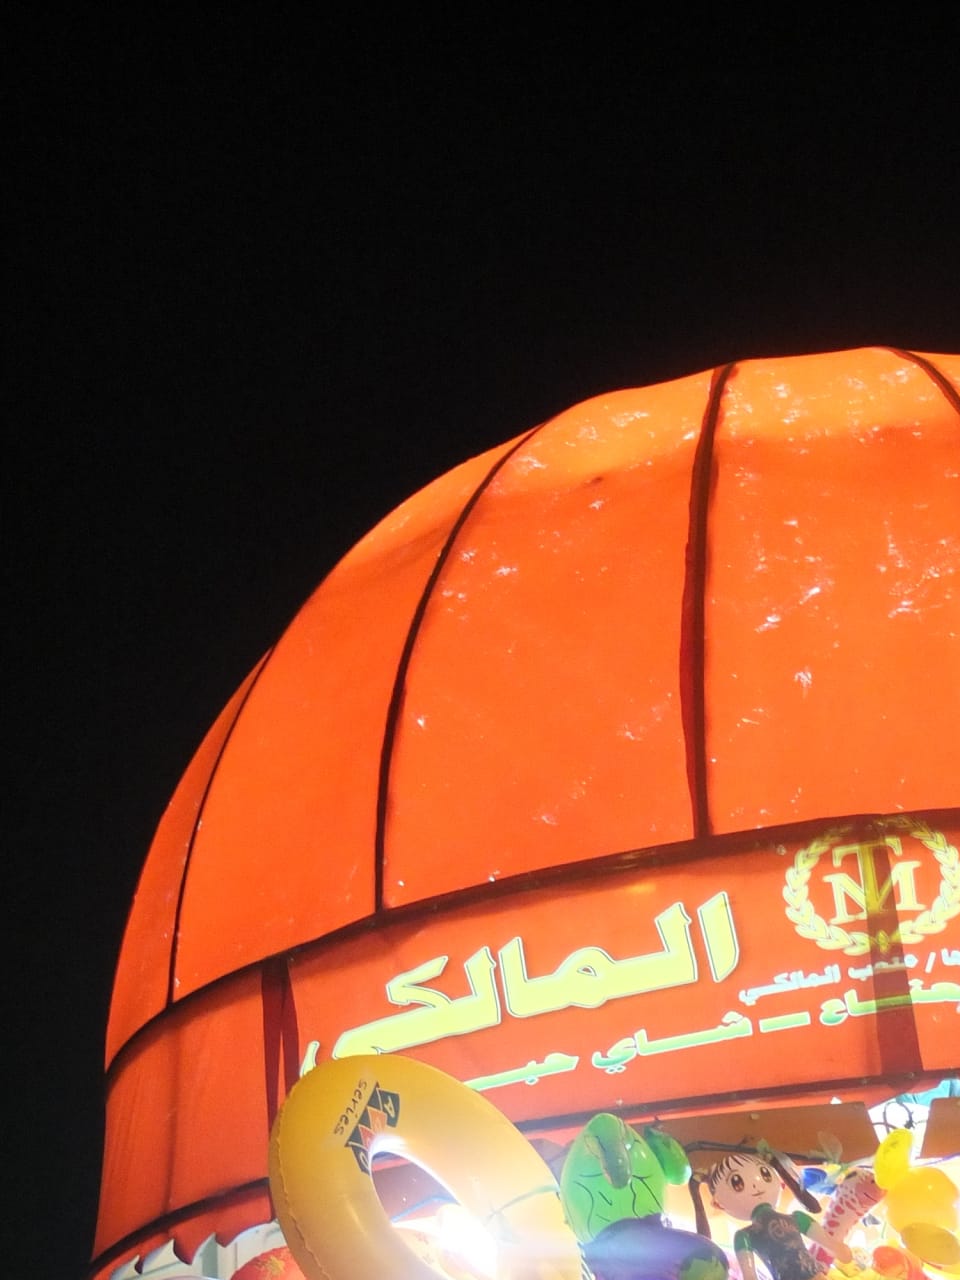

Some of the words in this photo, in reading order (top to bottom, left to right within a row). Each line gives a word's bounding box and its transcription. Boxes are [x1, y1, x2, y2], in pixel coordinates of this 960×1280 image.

[300, 890, 739, 1078] المالك
[738, 963, 842, 1006] المالكي
[592, 1010, 753, 1075] شاي
[463, 1051, 580, 1093] حب
[333, 1079, 368, 1136] series
